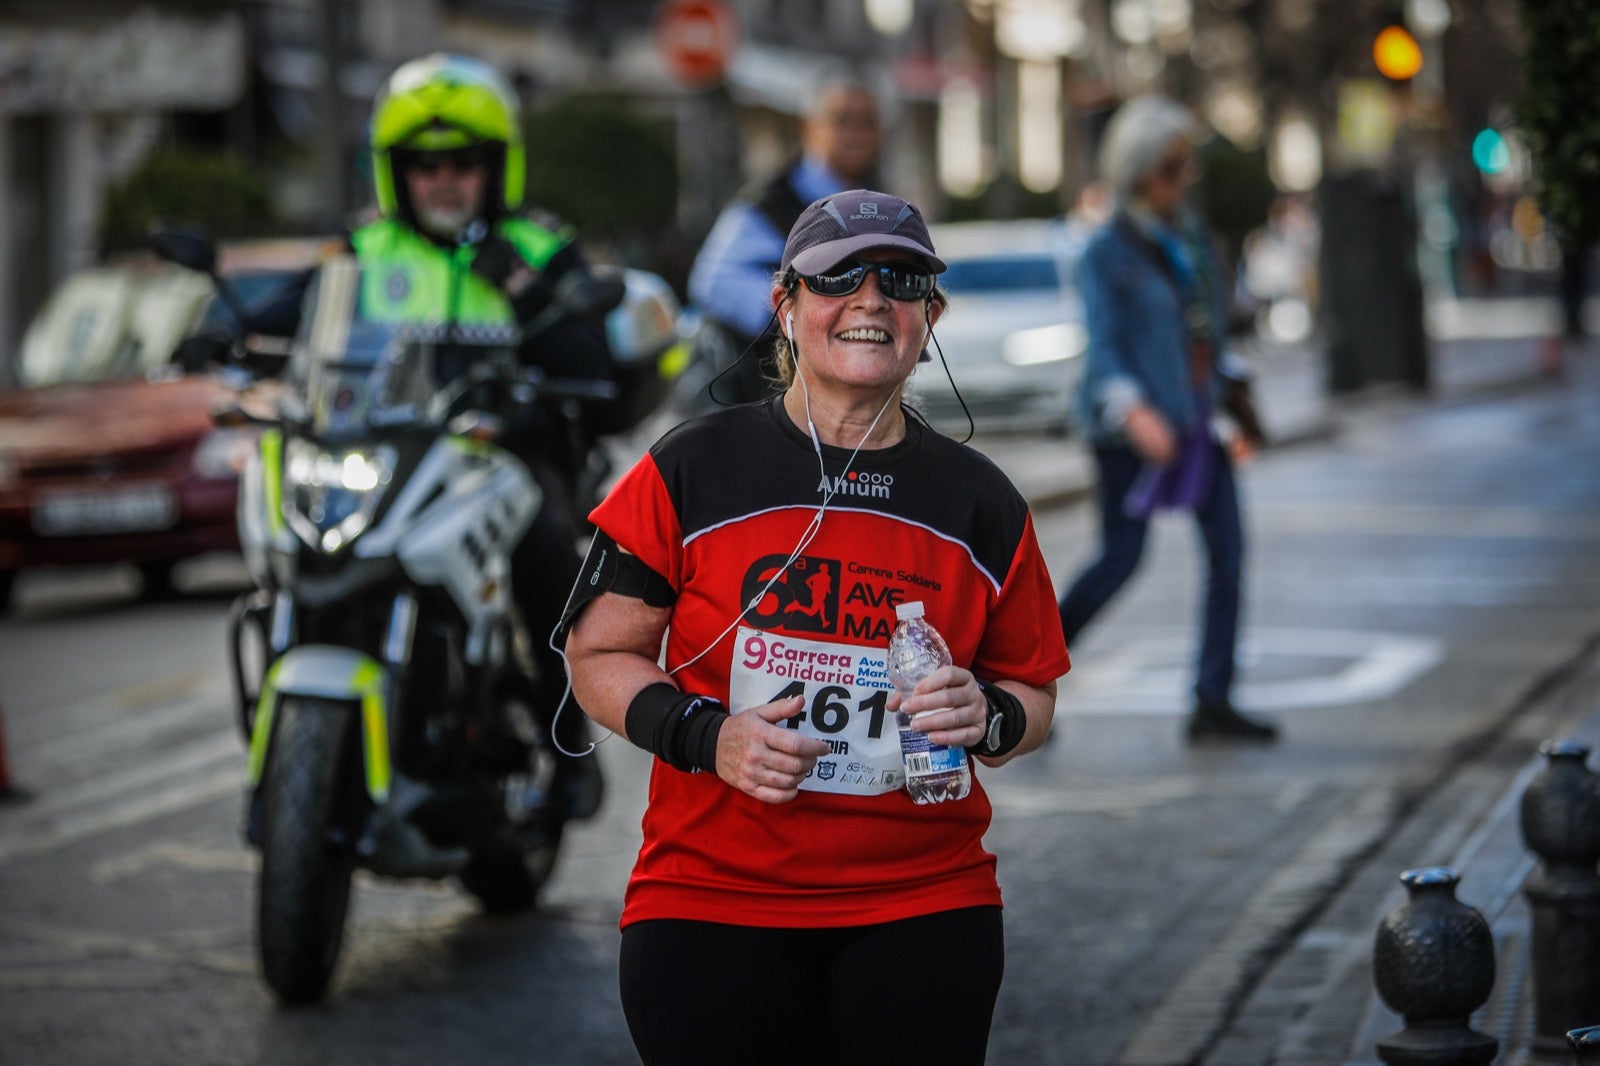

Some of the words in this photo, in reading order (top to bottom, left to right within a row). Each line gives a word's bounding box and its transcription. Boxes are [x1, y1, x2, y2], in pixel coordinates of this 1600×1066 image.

[817, 472, 890, 500] Altium
[848, 561, 893, 579] Carrera
[897, 570, 942, 592] Solidaria
[845, 582, 905, 611] AVE
[770, 642, 851, 668] Carrera
[859, 657, 885, 668] Ave
[766, 659, 854, 685] Solidaria
[767, 680, 888, 739] 461
